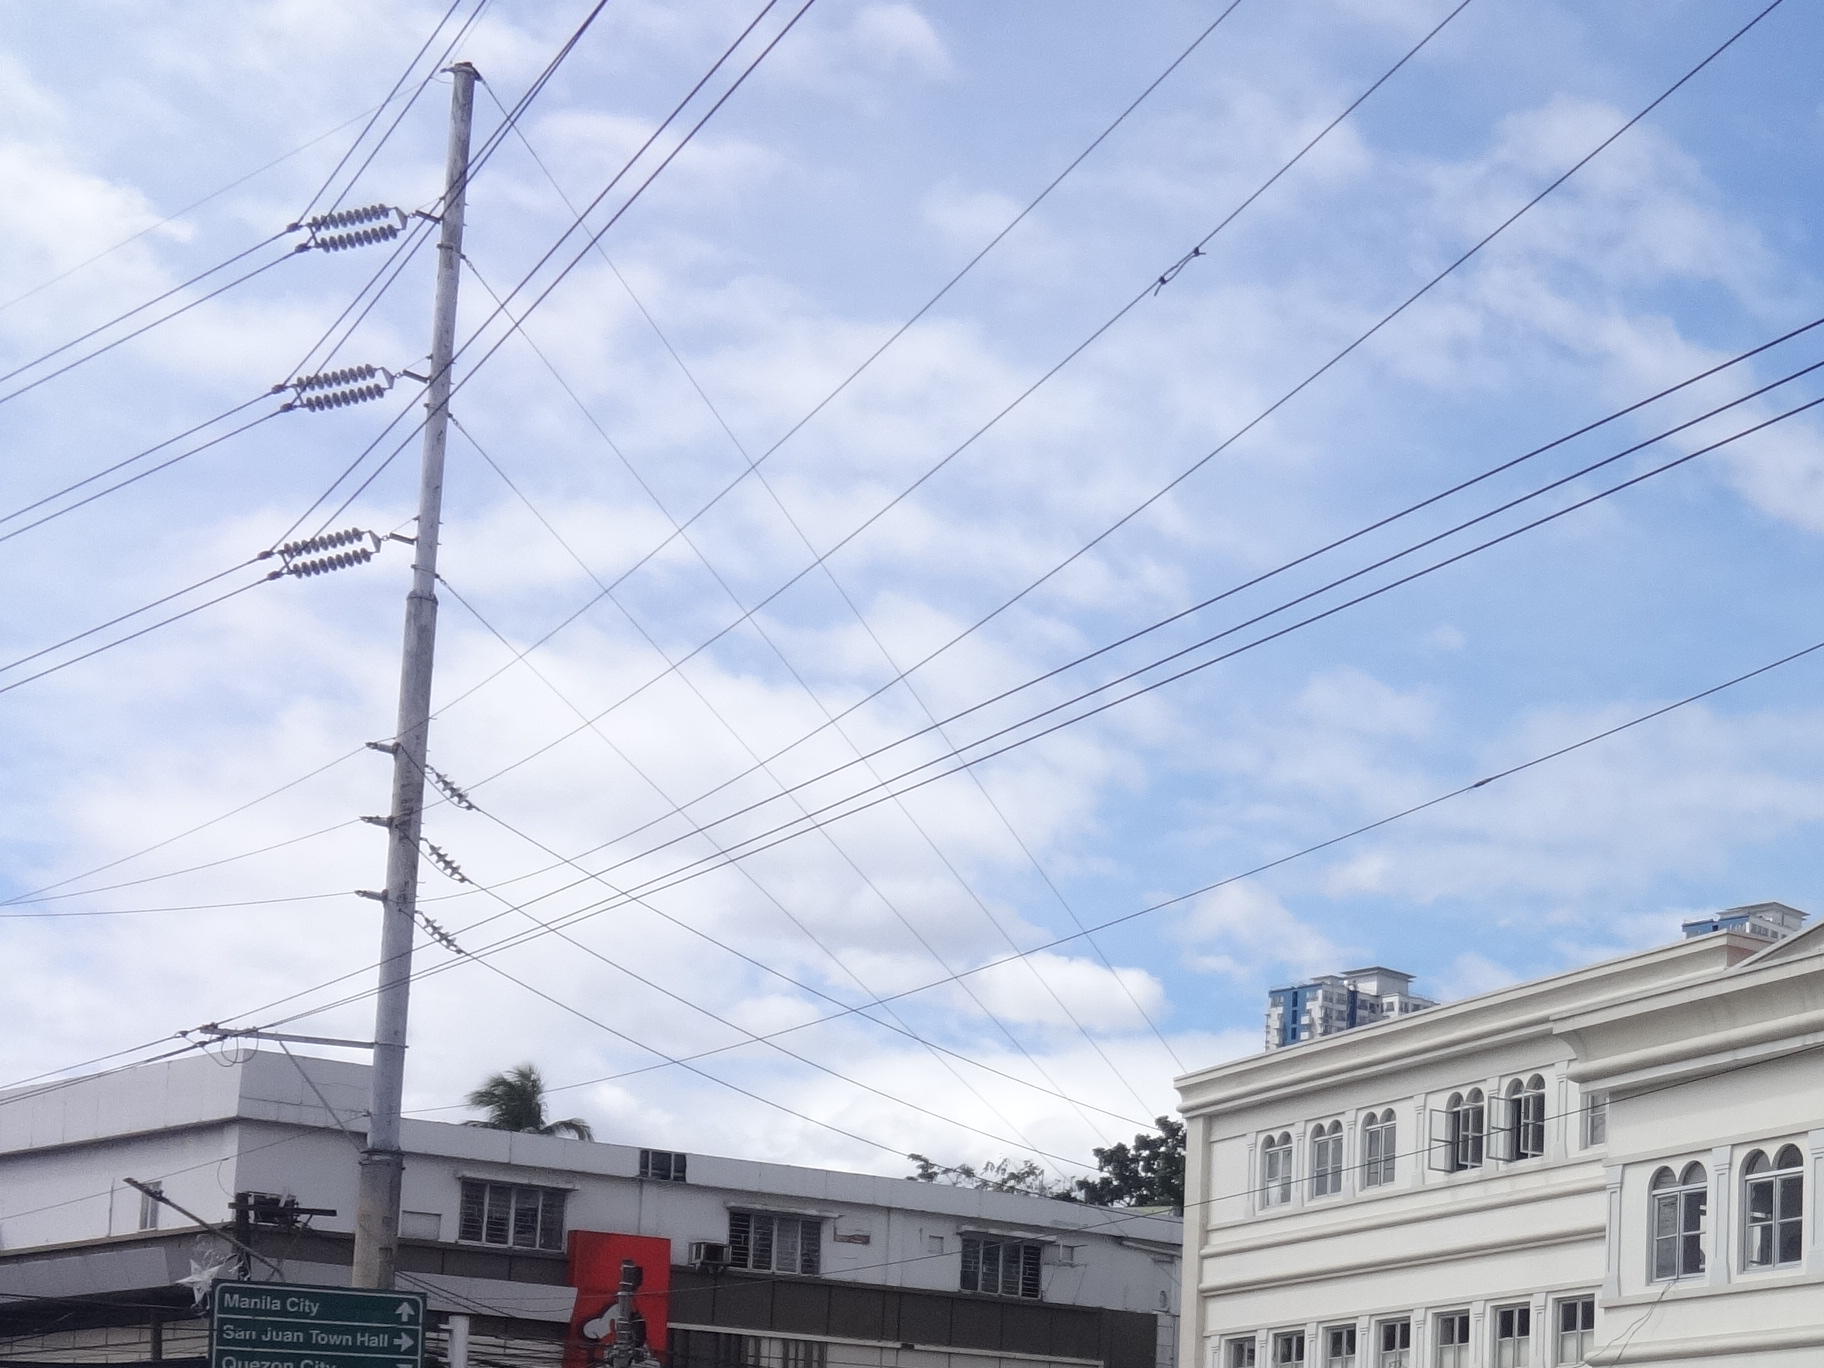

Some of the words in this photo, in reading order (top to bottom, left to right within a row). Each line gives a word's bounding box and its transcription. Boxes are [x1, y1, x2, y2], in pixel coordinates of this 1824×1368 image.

[223, 1292, 281, 1311] Manila
[286, 1297, 320, 1316] City
[222, 1324, 257, 1340] San
[261, 1327, 304, 1343] Juan
[309, 1330, 352, 1346] Town
[356, 1332, 389, 1348] Hall
